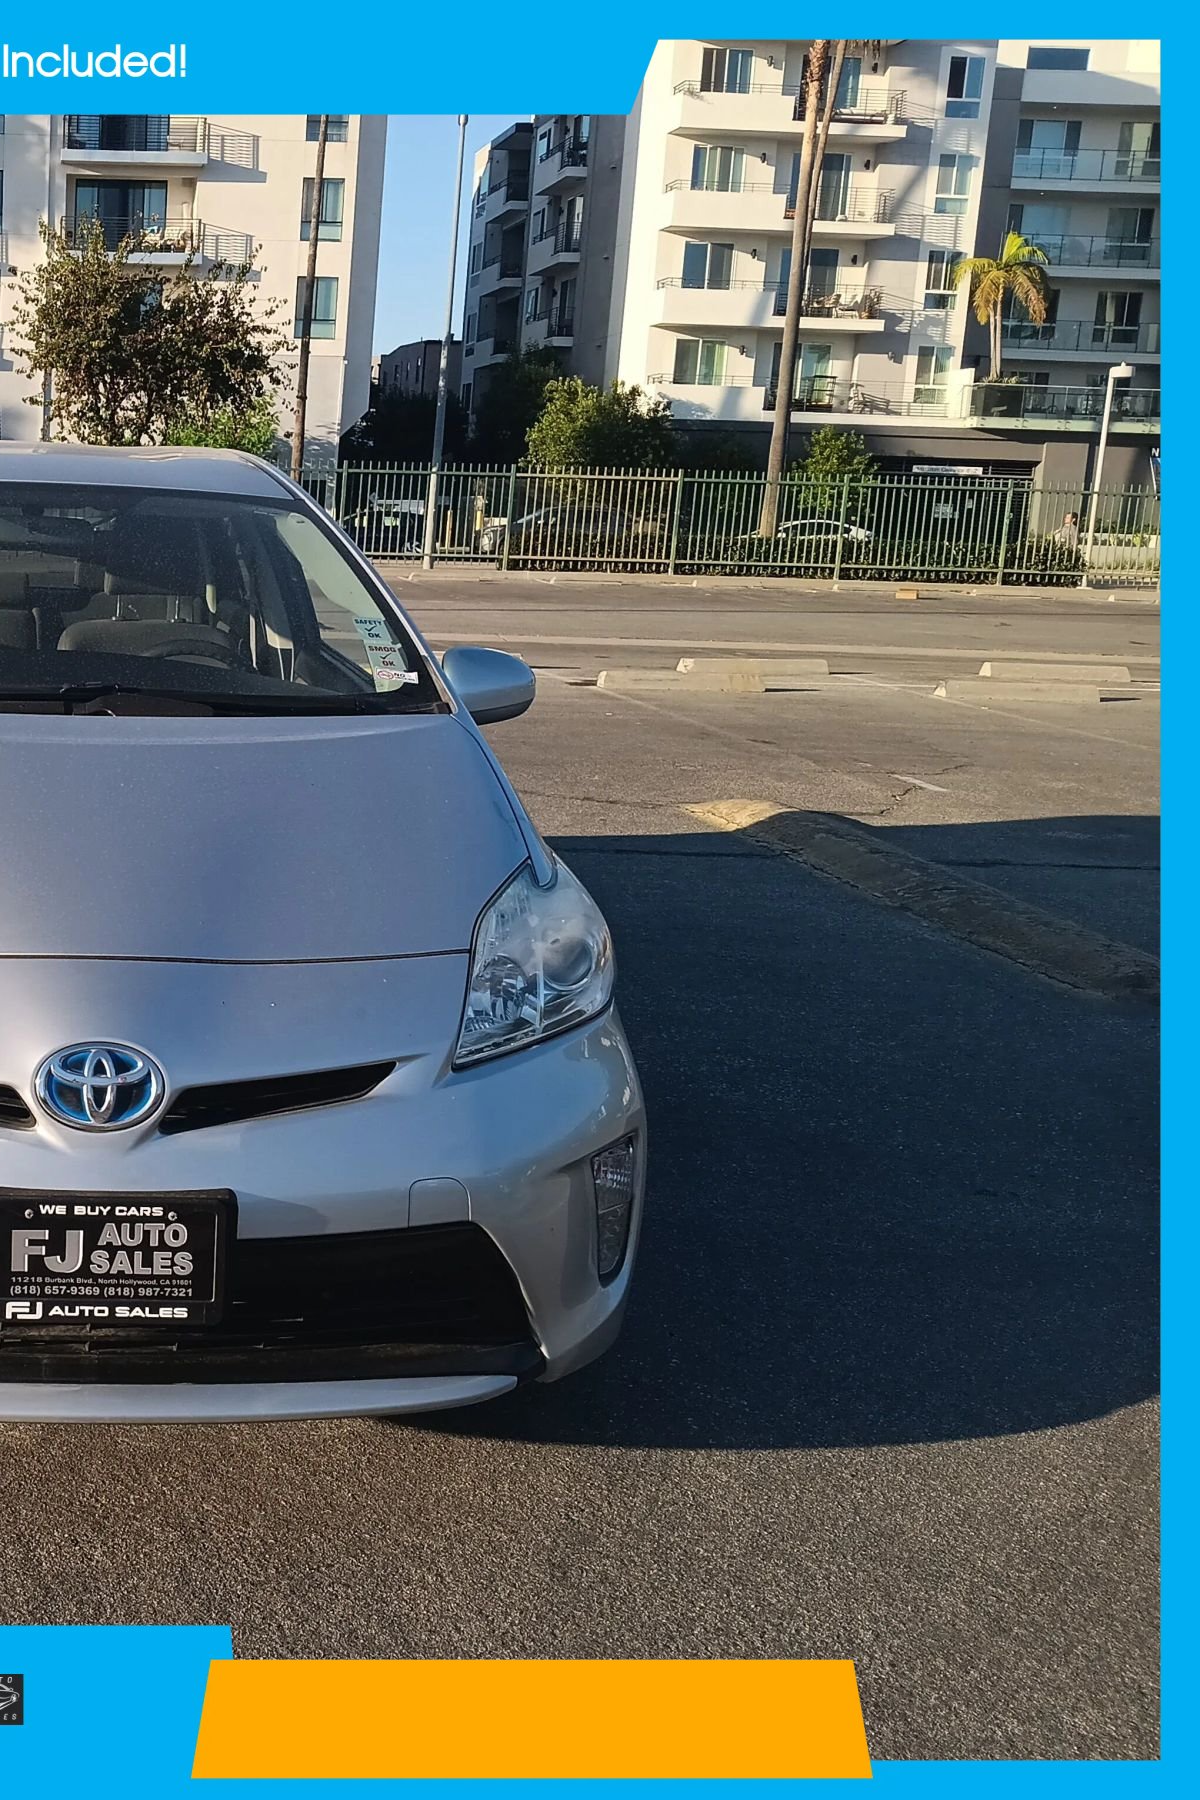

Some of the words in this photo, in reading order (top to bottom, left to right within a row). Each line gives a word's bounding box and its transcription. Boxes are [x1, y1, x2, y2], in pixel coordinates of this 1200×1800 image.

[39, 1204, 67, 1215] WE
[74, 1205, 111, 1216] BUY
[115, 1206, 164, 1217] CARS
[97, 1222, 188, 1247] AUTO
[11, 1229, 84, 1274] FJ
[89, 1250, 194, 1276] SALES
[45, 1276, 75, 1284] Burbank
[10, 1285, 41, 1297] (818)
[45, 1285, 100, 1296] 657-9369
[104, 1286, 135, 1298] (818)
[138, 1287, 192, 1297] 987-7321
[6, 1301, 43, 1320] FJ
[48, 1305, 109, 1317] AUTO
[115, 1306, 188, 1318] SALES
